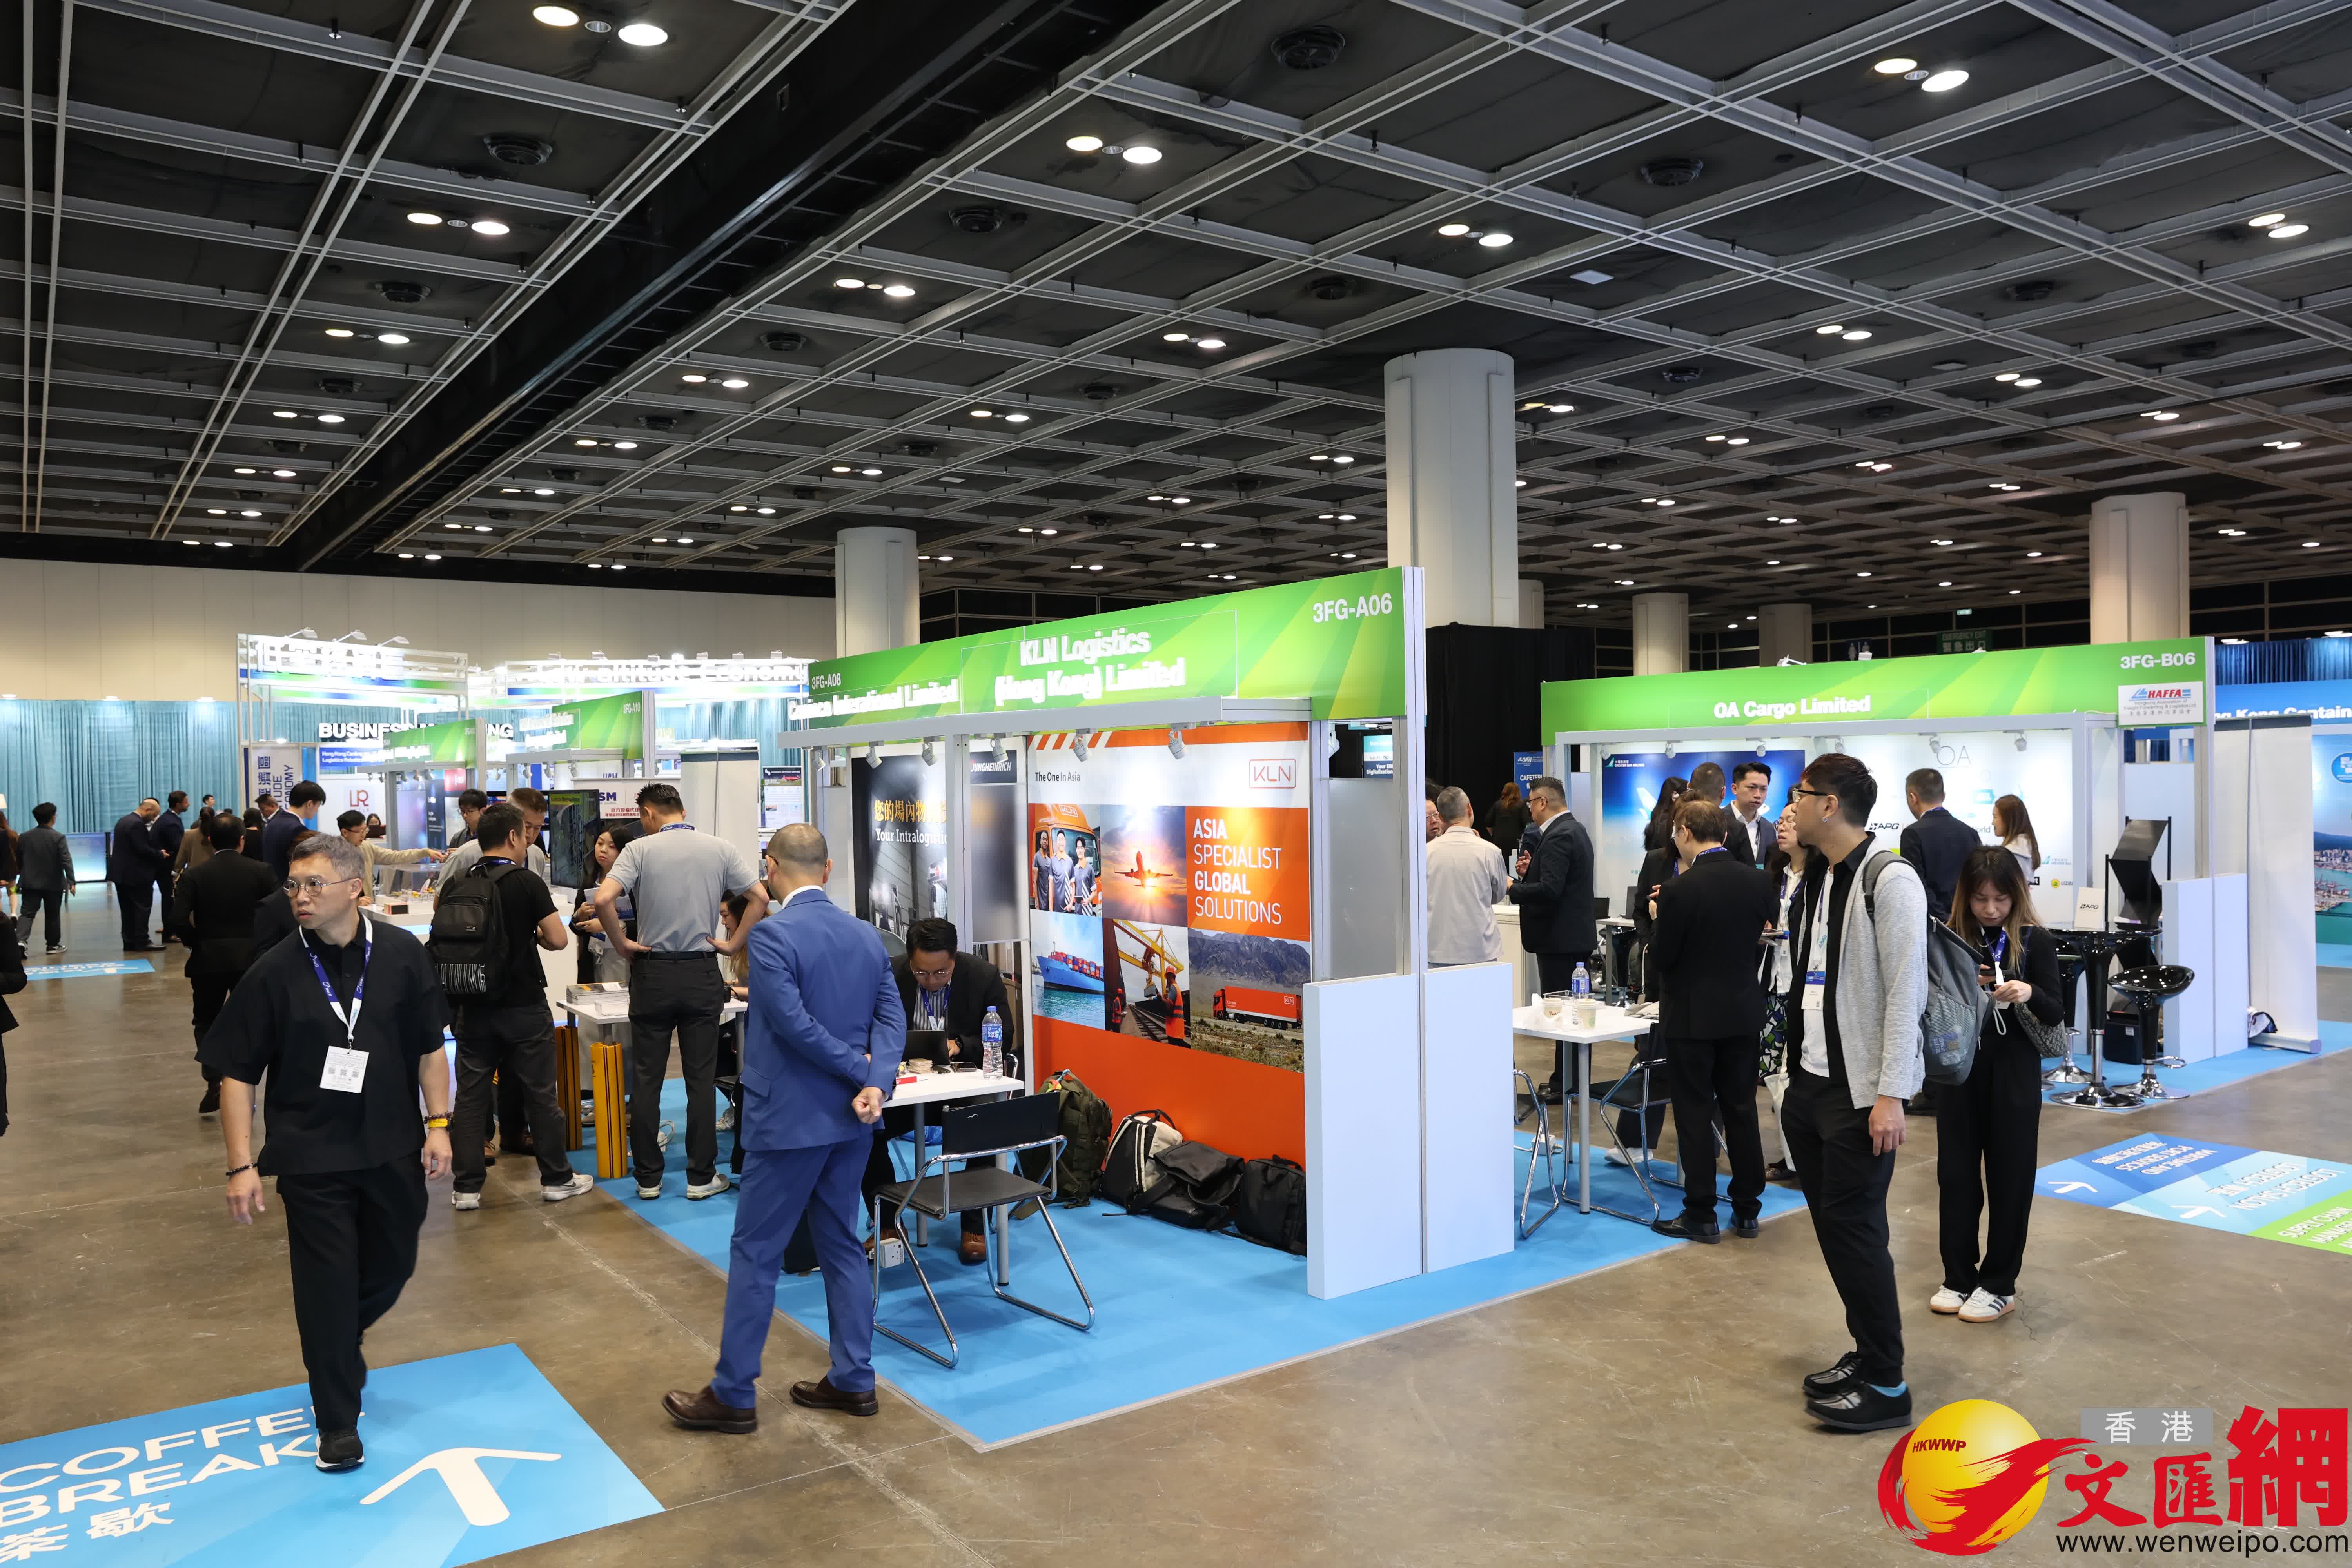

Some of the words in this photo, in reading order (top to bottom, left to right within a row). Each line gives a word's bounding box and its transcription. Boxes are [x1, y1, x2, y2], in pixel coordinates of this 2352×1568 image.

[1312, 593, 1392, 623] 3FG-A06
[1020, 637, 1058, 666] KLN
[1062, 628, 1151, 664] Logistics
[2120, 652, 2196, 669] 3FG-B06
[812, 673, 841, 690] 3FG-A08
[1047, 666, 1103, 700] Kong)
[1106, 657, 1185, 691] Limited
[905, 679, 959, 707] Limited
[2148, 689, 2181, 699] HAFFA
[1713, 701, 1740, 719] OA
[1743, 700, 1796, 719] Cargo
[1800, 694, 1871, 714] Limited
[971, 762, 1012, 773] JUNGHEINRICH
[1936, 745, 1971, 766] OA
[1035, 772, 1046, 782] The
[1047, 771, 1059, 782] One
[1060, 771, 1066, 781] In
[1067, 771, 1081, 781] Asia
[1254, 765, 1291, 783] KLN
[1060, 806, 1076, 815] KLN
[875, 828, 894, 842] Your
[1193, 818, 1227, 839] ASIA
[1194, 844, 1282, 869] SPECIALIST
[1194, 871, 1251, 895] GLOBAL
[1195, 896, 1282, 925] SOLUTIONS
[0, 1406, 366, 1494] COFFE
[0, 1433, 319, 1528] BREAK
[0, 1501, 175, 1564] 茶歇
